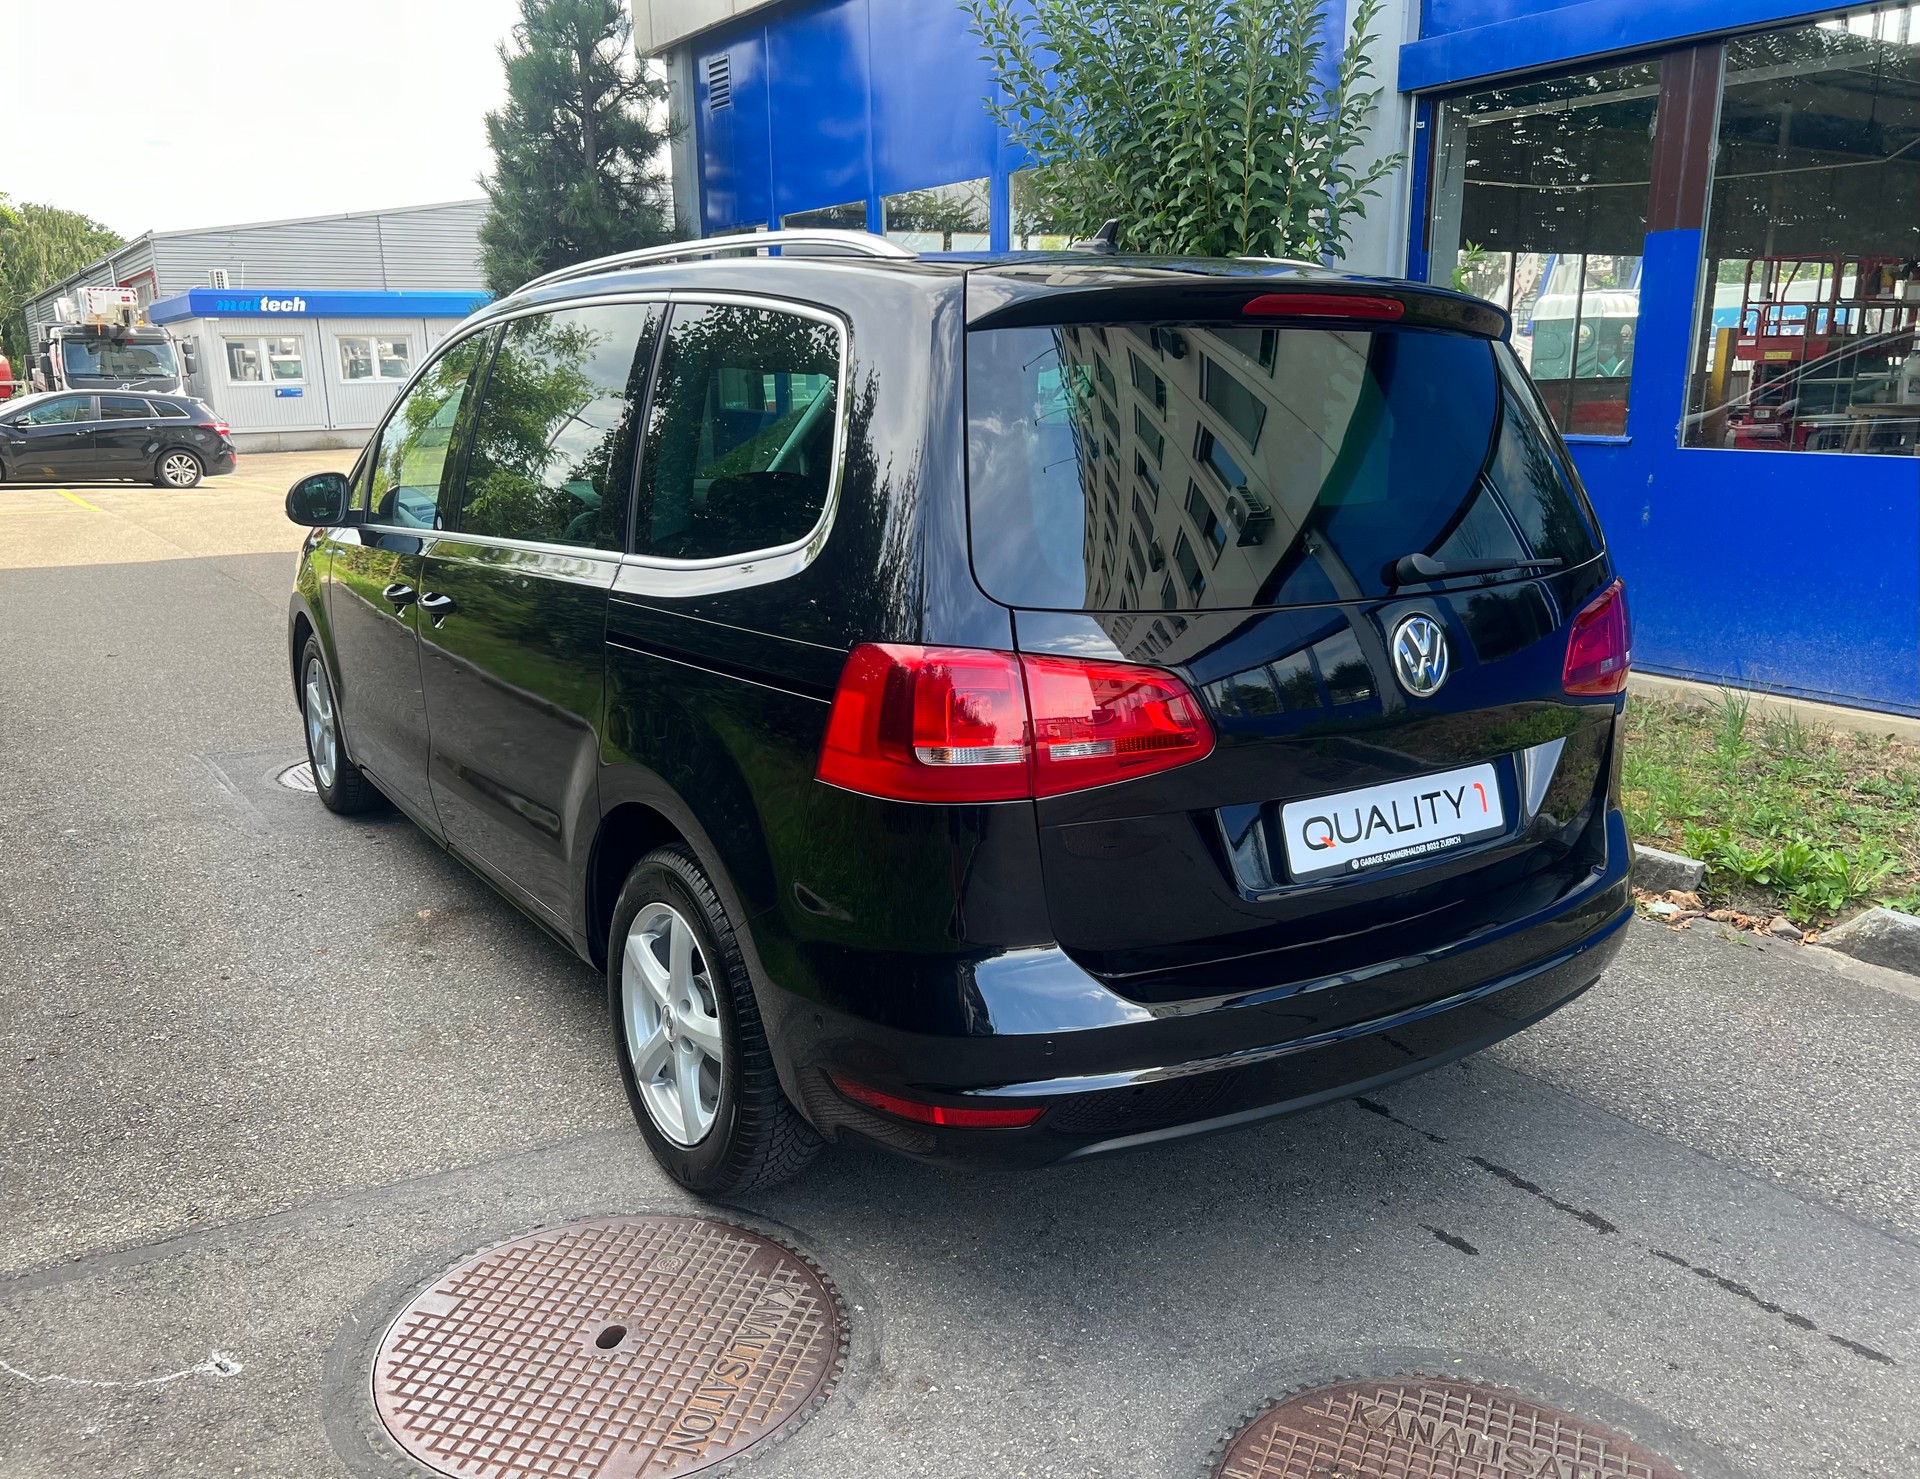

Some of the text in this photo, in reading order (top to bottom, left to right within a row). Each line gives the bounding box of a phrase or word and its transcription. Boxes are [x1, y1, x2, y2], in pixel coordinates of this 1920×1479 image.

[216, 296, 306, 312] maltech
[1302, 782, 1488, 851] QUALITY 1
[1360, 854, 1383, 867] GARAGE
[1383, 844, 1427, 862] SOMMERHALDER
[1426, 842, 1440, 852] 8032
[1440, 835, 1462, 848] ZUERICH
[661, 1283, 800, 1455] KANALISATION
